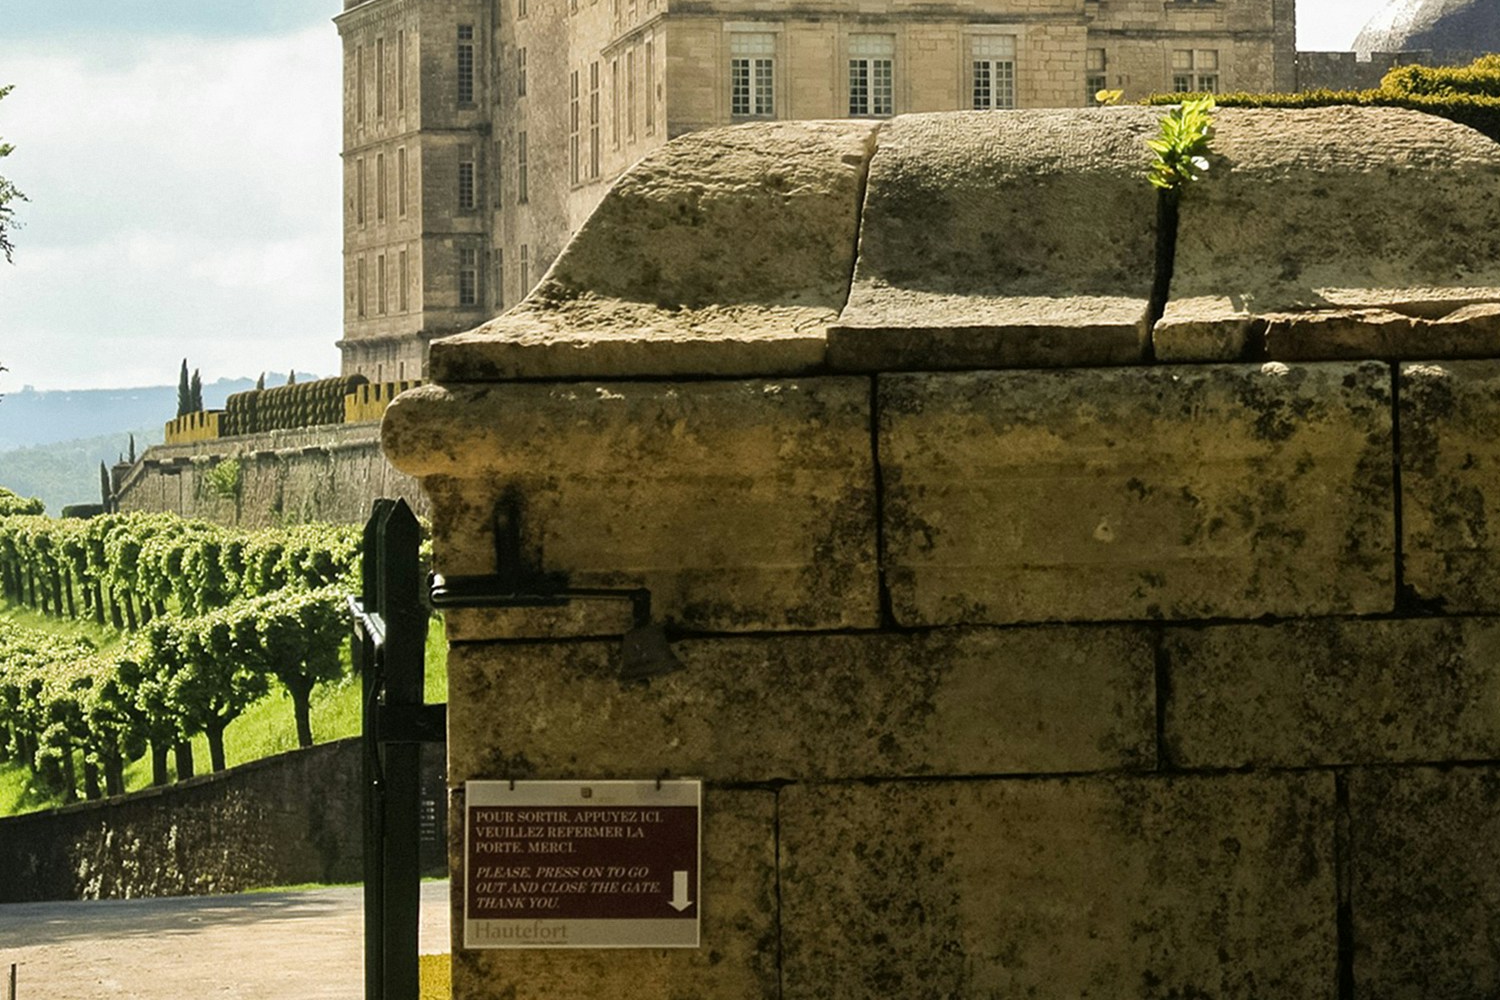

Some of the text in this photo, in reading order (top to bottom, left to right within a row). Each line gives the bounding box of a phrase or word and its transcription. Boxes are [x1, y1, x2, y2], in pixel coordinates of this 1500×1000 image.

[476, 811, 514, 823] POUR
[574, 811, 637, 823] APPUYEZ
[476, 827, 644, 838] VEUILLEZ REFERMER LA
[536, 867, 580, 878] PRESS
[582, 867, 603, 878] ON
[607, 867, 626, 878] TO
[628, 867, 649, 878] GO
[476, 882, 507, 893] OUT
[507, 882, 539, 893] AND
[541, 882, 588, 893] CLOSE
[590, 882, 620, 893] THE
[476, 898, 526, 909] THANK
[475, 921, 567, 939] Hautefort
